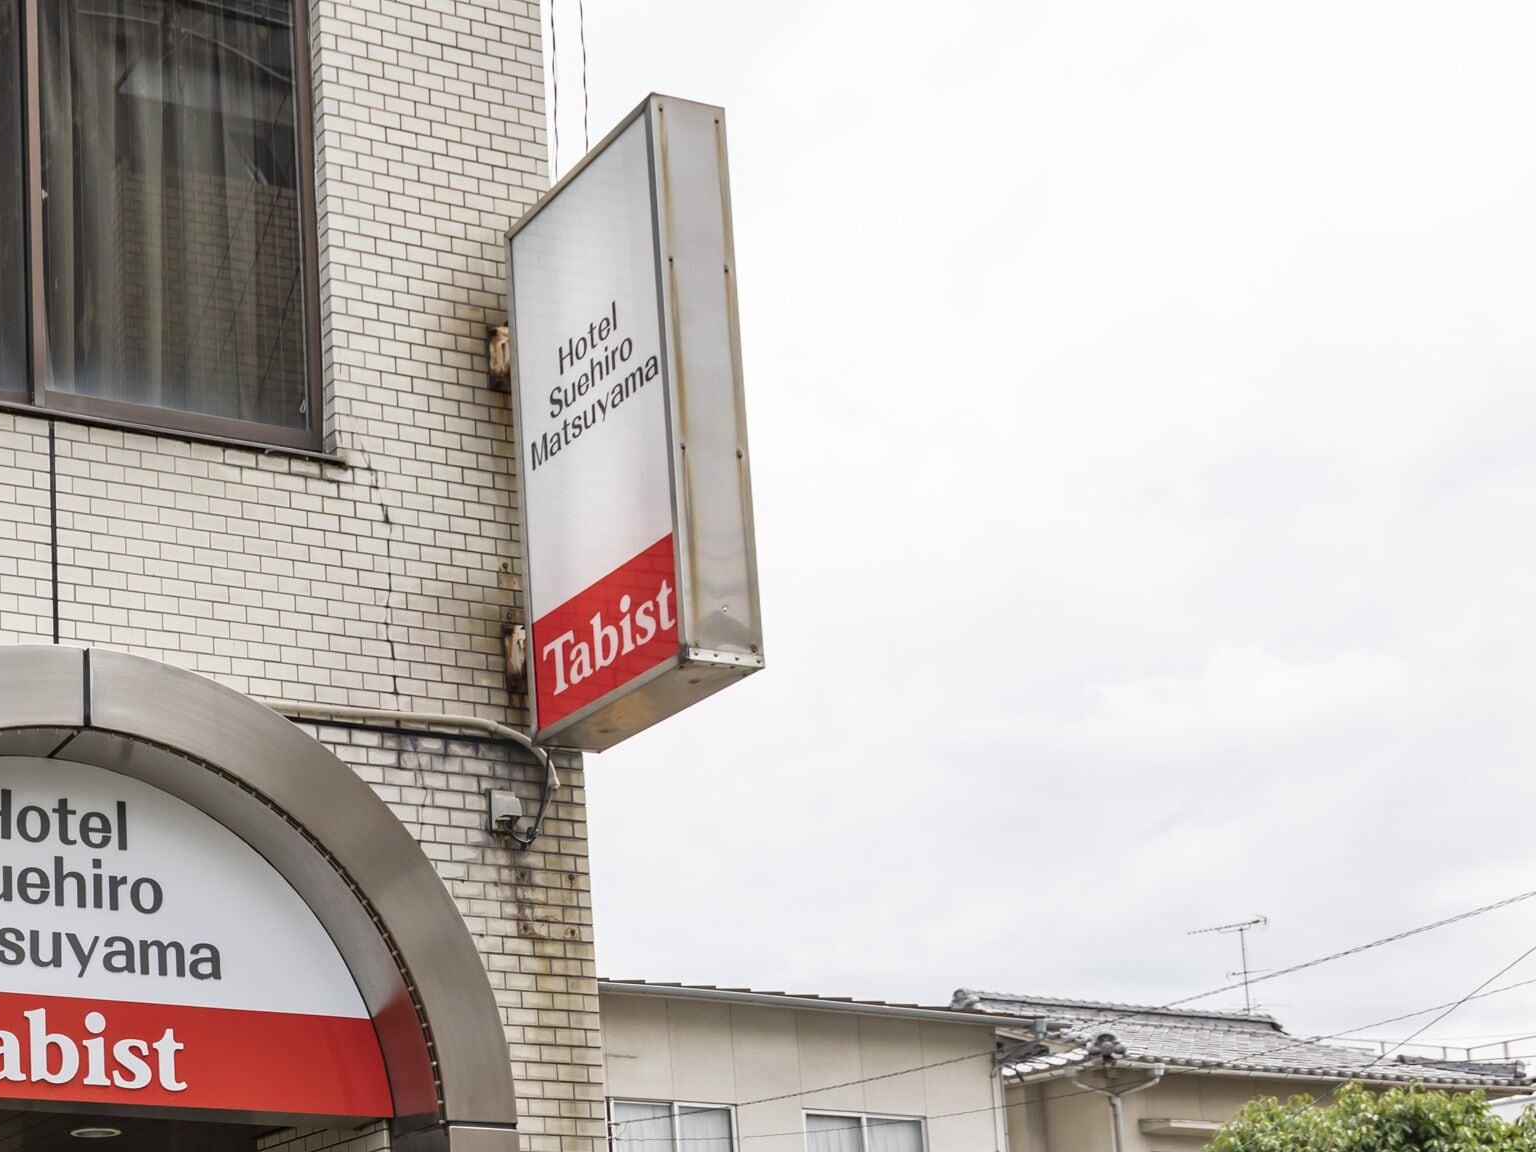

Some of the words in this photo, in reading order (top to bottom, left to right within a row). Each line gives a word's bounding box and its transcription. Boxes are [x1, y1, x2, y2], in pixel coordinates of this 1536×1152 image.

[548, 336, 633, 419] Suehiro
[558, 301, 618, 376] Hotel
[530, 353, 659, 471] Matsuyama
[542, 579, 676, 697] Tabist
